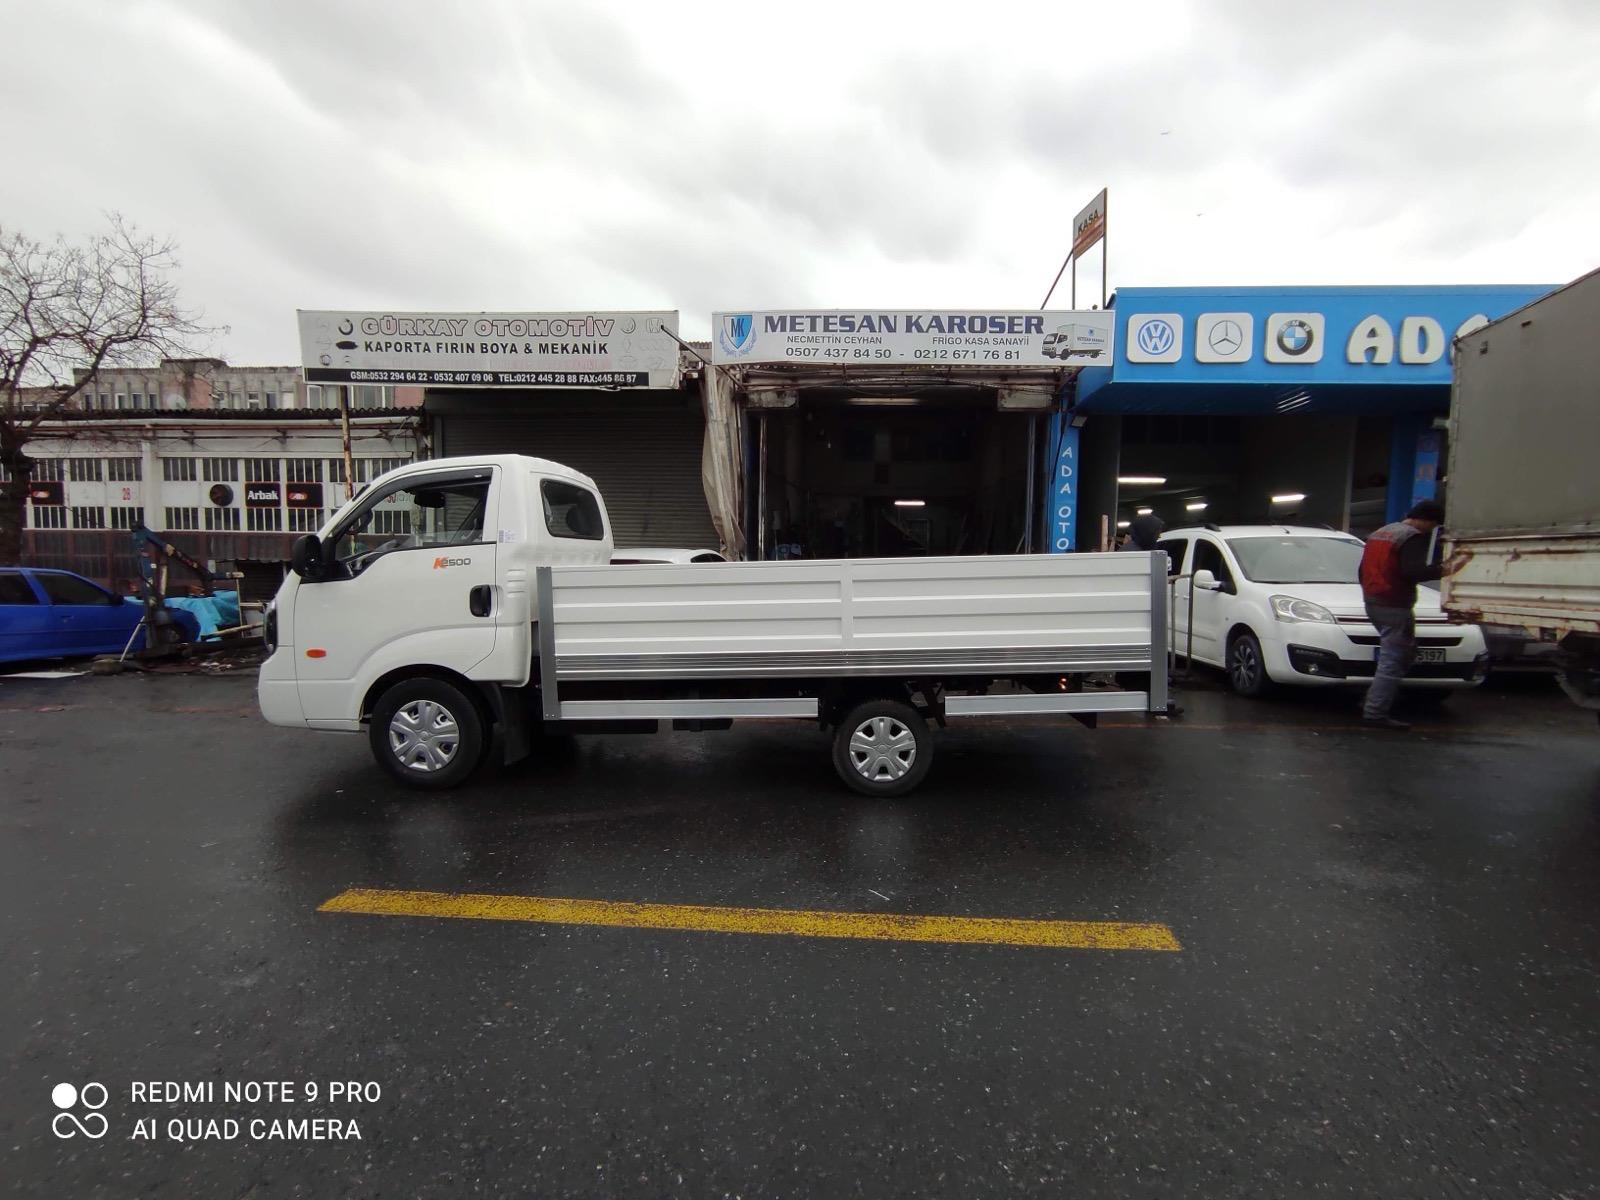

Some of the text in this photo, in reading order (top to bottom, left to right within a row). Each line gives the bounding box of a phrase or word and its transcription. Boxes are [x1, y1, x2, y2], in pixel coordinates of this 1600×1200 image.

[361, 315, 615, 337] GÜRKAY OTOMOTİV
[764, 315, 1044, 334] METESAN KAROSER
[787, 335, 882, 345] NECMETTİN CEYHAN
[932, 335, 962, 345] FRİGO
[965, 336, 990, 345] KASA
[364, 340, 609, 355] KAPORTA FIRIN BOYA & MEKANİK
[785, 347, 819, 357] 0507
[823, 348, 849, 358] 437
[853, 348, 871, 358] 84
[874, 349, 892, 359] 50
[914, 349, 948, 359] 0212
[952, 349, 977, 360] 671
[982, 350, 1000, 360] 76
[1004, 350, 1020, 360] 81
[390, 371, 404, 381] 294
[419, 372, 428, 381] 22
[434, 372, 454, 381] 0532
[455, 373, 469, 382] 407
[498, 373, 536, 383] TEL:0212
[538, 374, 553, 383] 445
[247, 490, 279, 501] Arbak
[1056, 446, 1073, 550] ADA OTO
